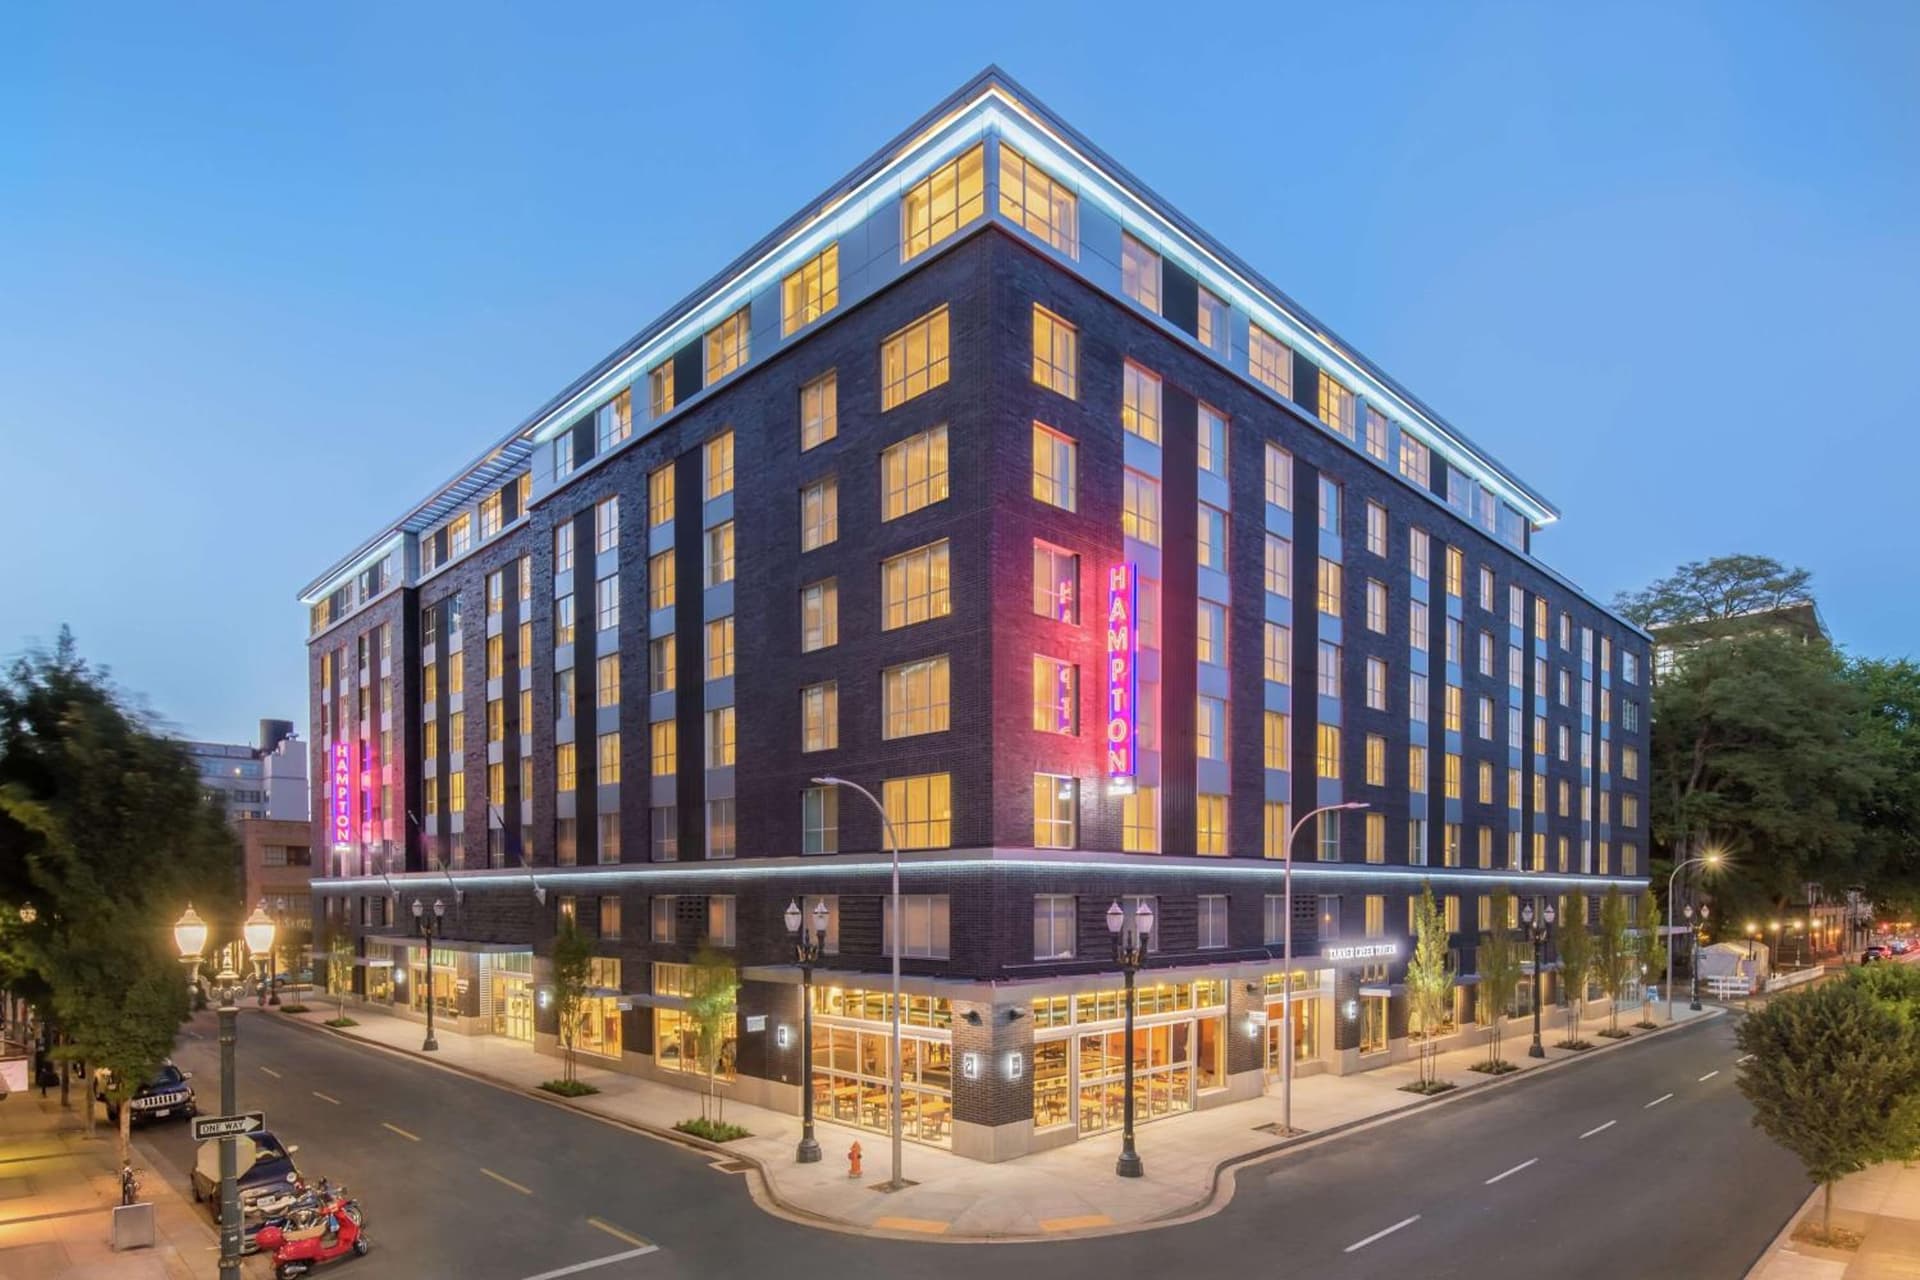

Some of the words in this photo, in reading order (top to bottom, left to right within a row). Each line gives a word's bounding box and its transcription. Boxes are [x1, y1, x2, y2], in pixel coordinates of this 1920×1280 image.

[1108, 565, 1128, 773] HAMPTON
[336, 744, 349, 841] HAMPTON
[202, 1123, 219, 1134] ONE
[225, 1120, 244, 1130] WAY
